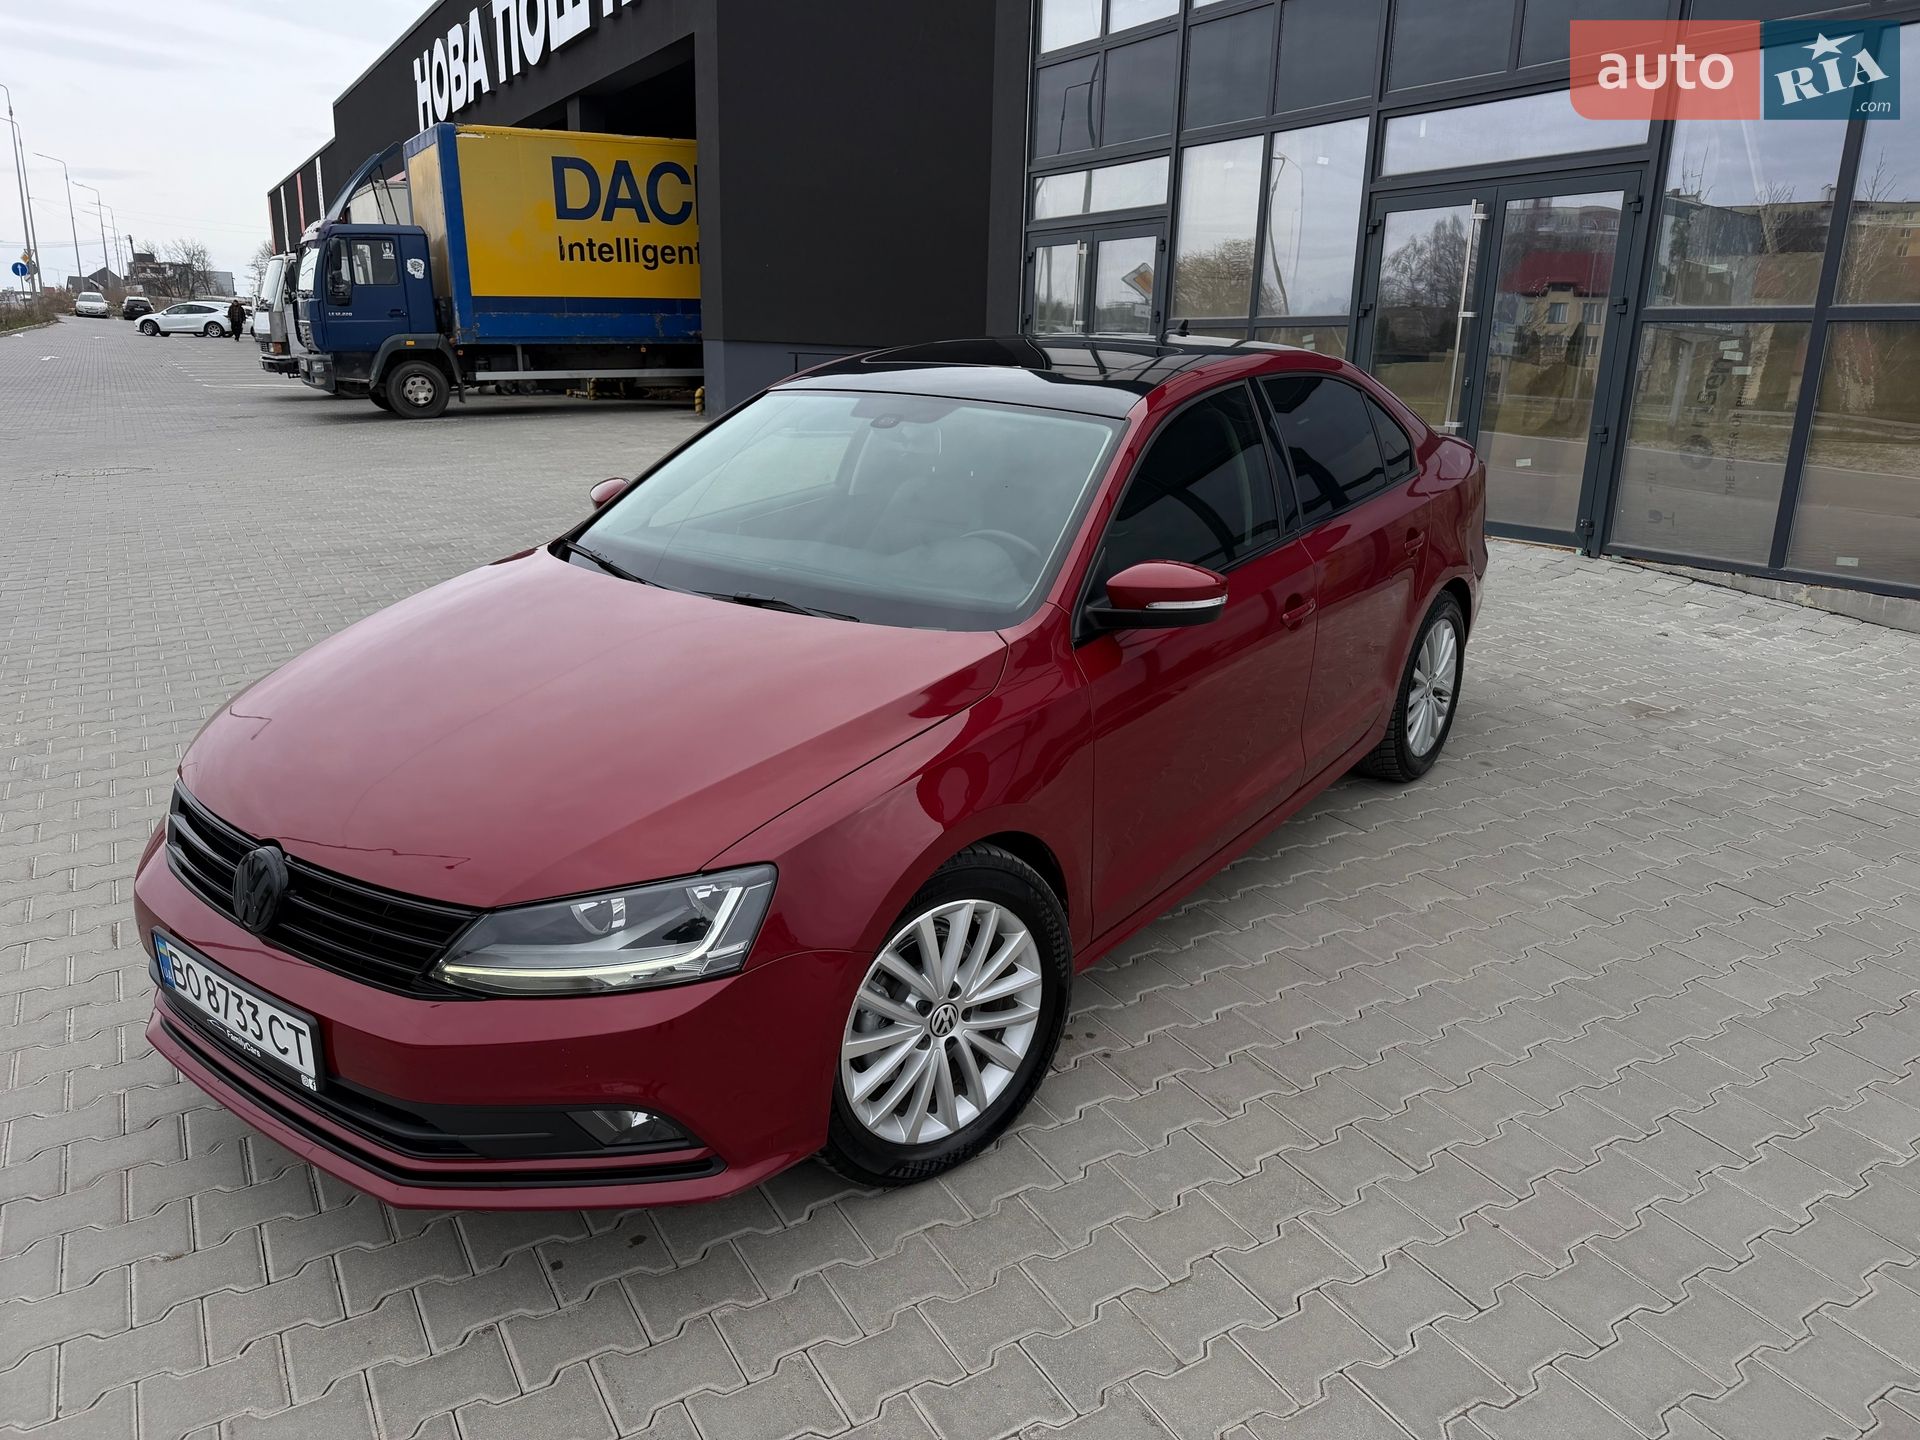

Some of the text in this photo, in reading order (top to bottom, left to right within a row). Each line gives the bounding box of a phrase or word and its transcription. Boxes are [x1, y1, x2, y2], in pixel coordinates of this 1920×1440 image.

[413, 7, 490, 133] НОВА
[551, 156, 700, 226] DAC
[169, 950, 307, 1067] BO 8733 CT
